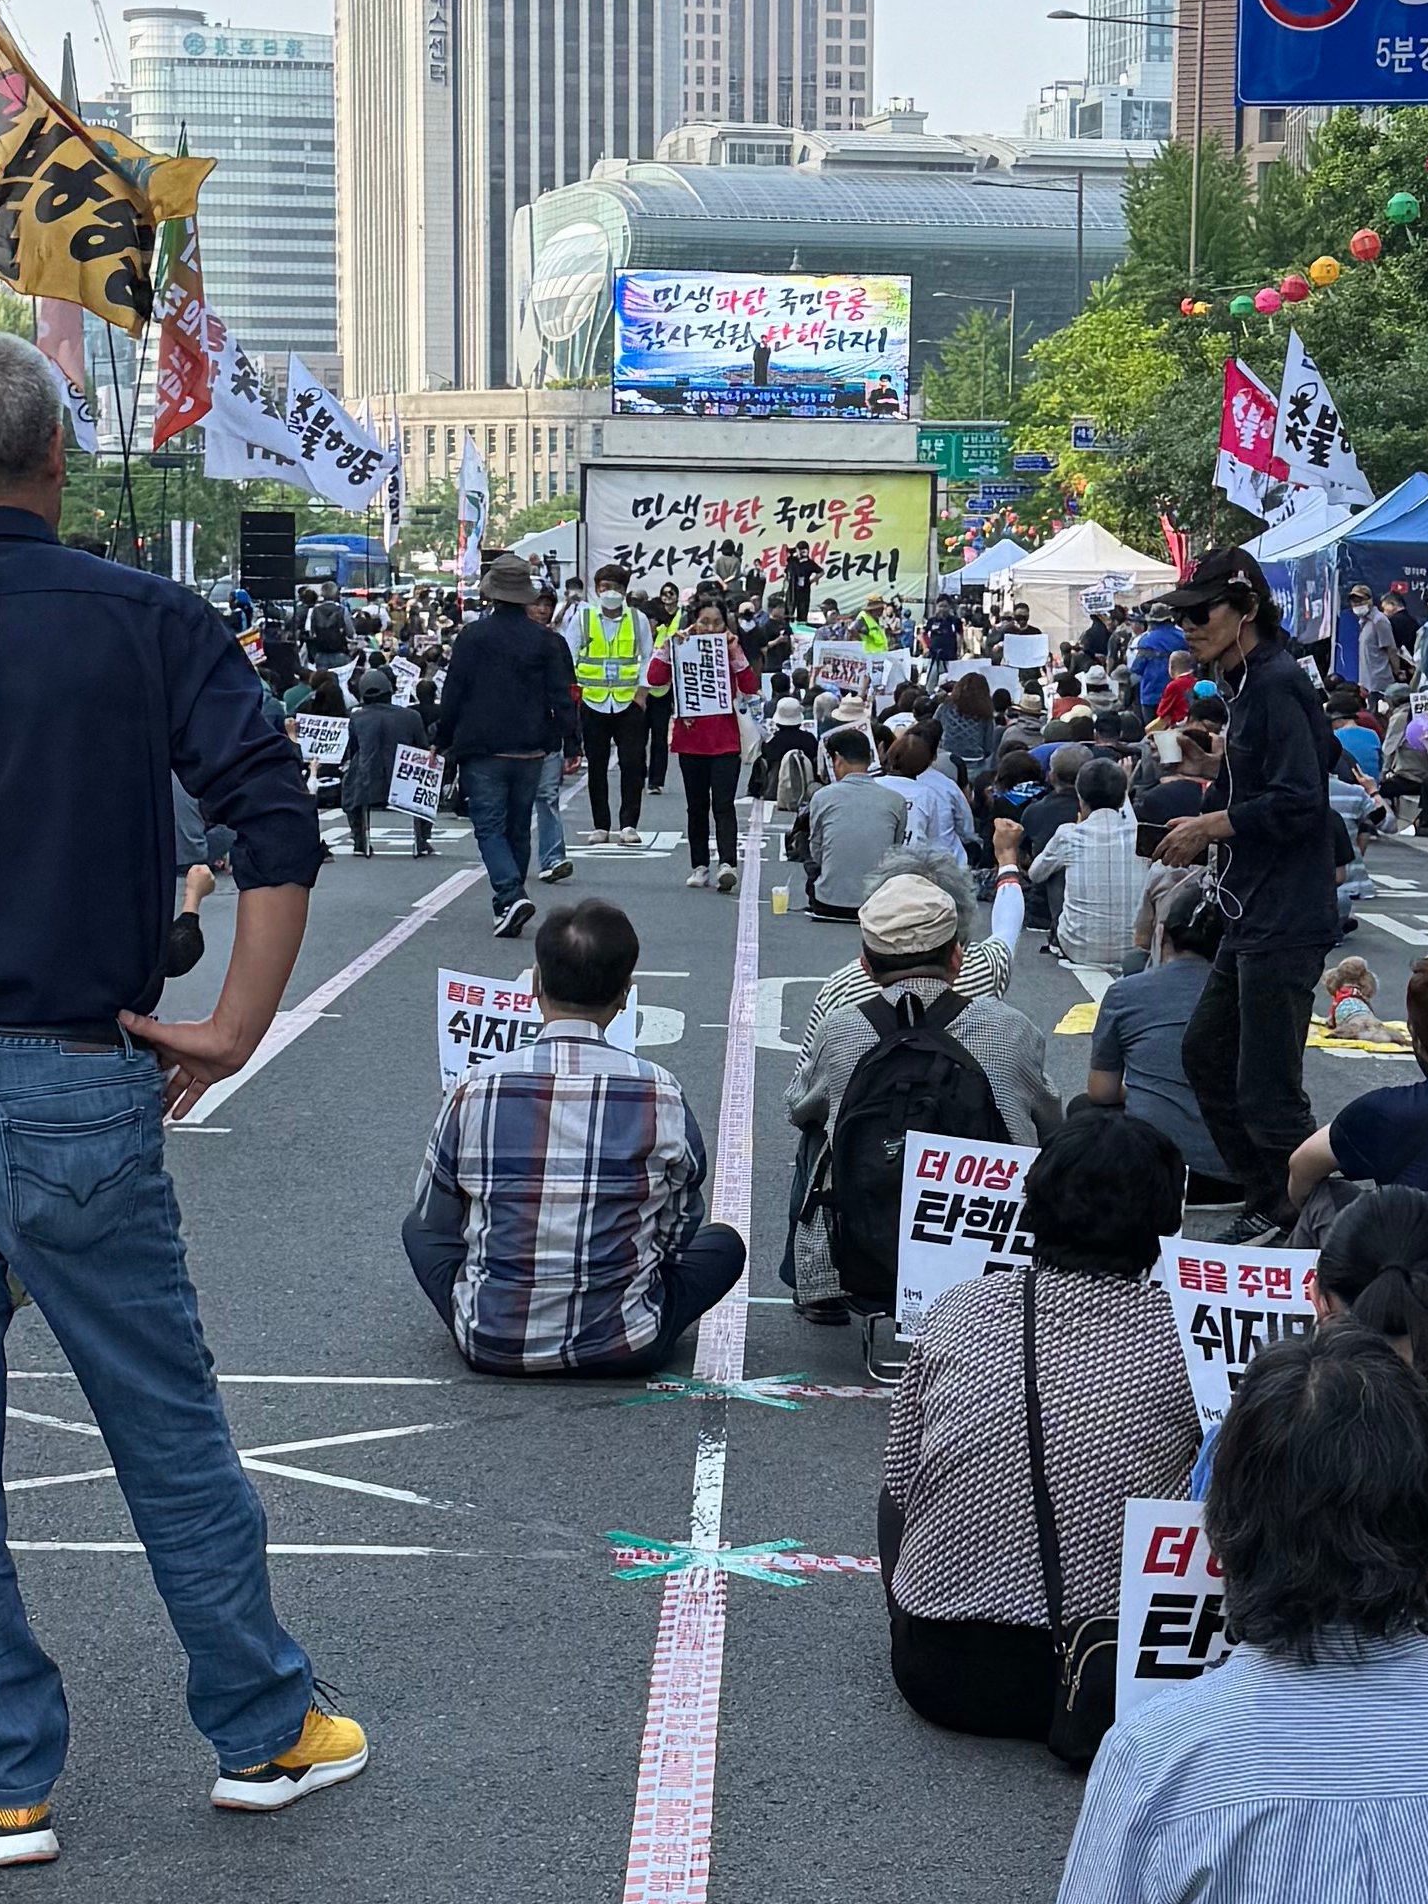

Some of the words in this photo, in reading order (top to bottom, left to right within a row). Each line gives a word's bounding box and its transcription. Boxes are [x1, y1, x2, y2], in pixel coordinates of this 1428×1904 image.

[653, 284, 770, 318] 민생파탄,
[777, 287, 876, 321] 국민우롱
[637, 320, 757, 353] 참사정권
[632, 493, 766, 537] 민생파탄,
[773, 494, 882, 541] 국민우롱
[613, 539, 744, 580] 참사정
[759, 539, 900, 590] 탄하자!
[447, 980, 485, 1007] 틈을
[915, 1149, 945, 1183] 더
[953, 1154, 1019, 1192] 이상
[1176, 1256, 1231, 1295] 틈을
[1237, 1263, 1295, 1300] 주면
[1142, 1526, 1195, 1578] 더
